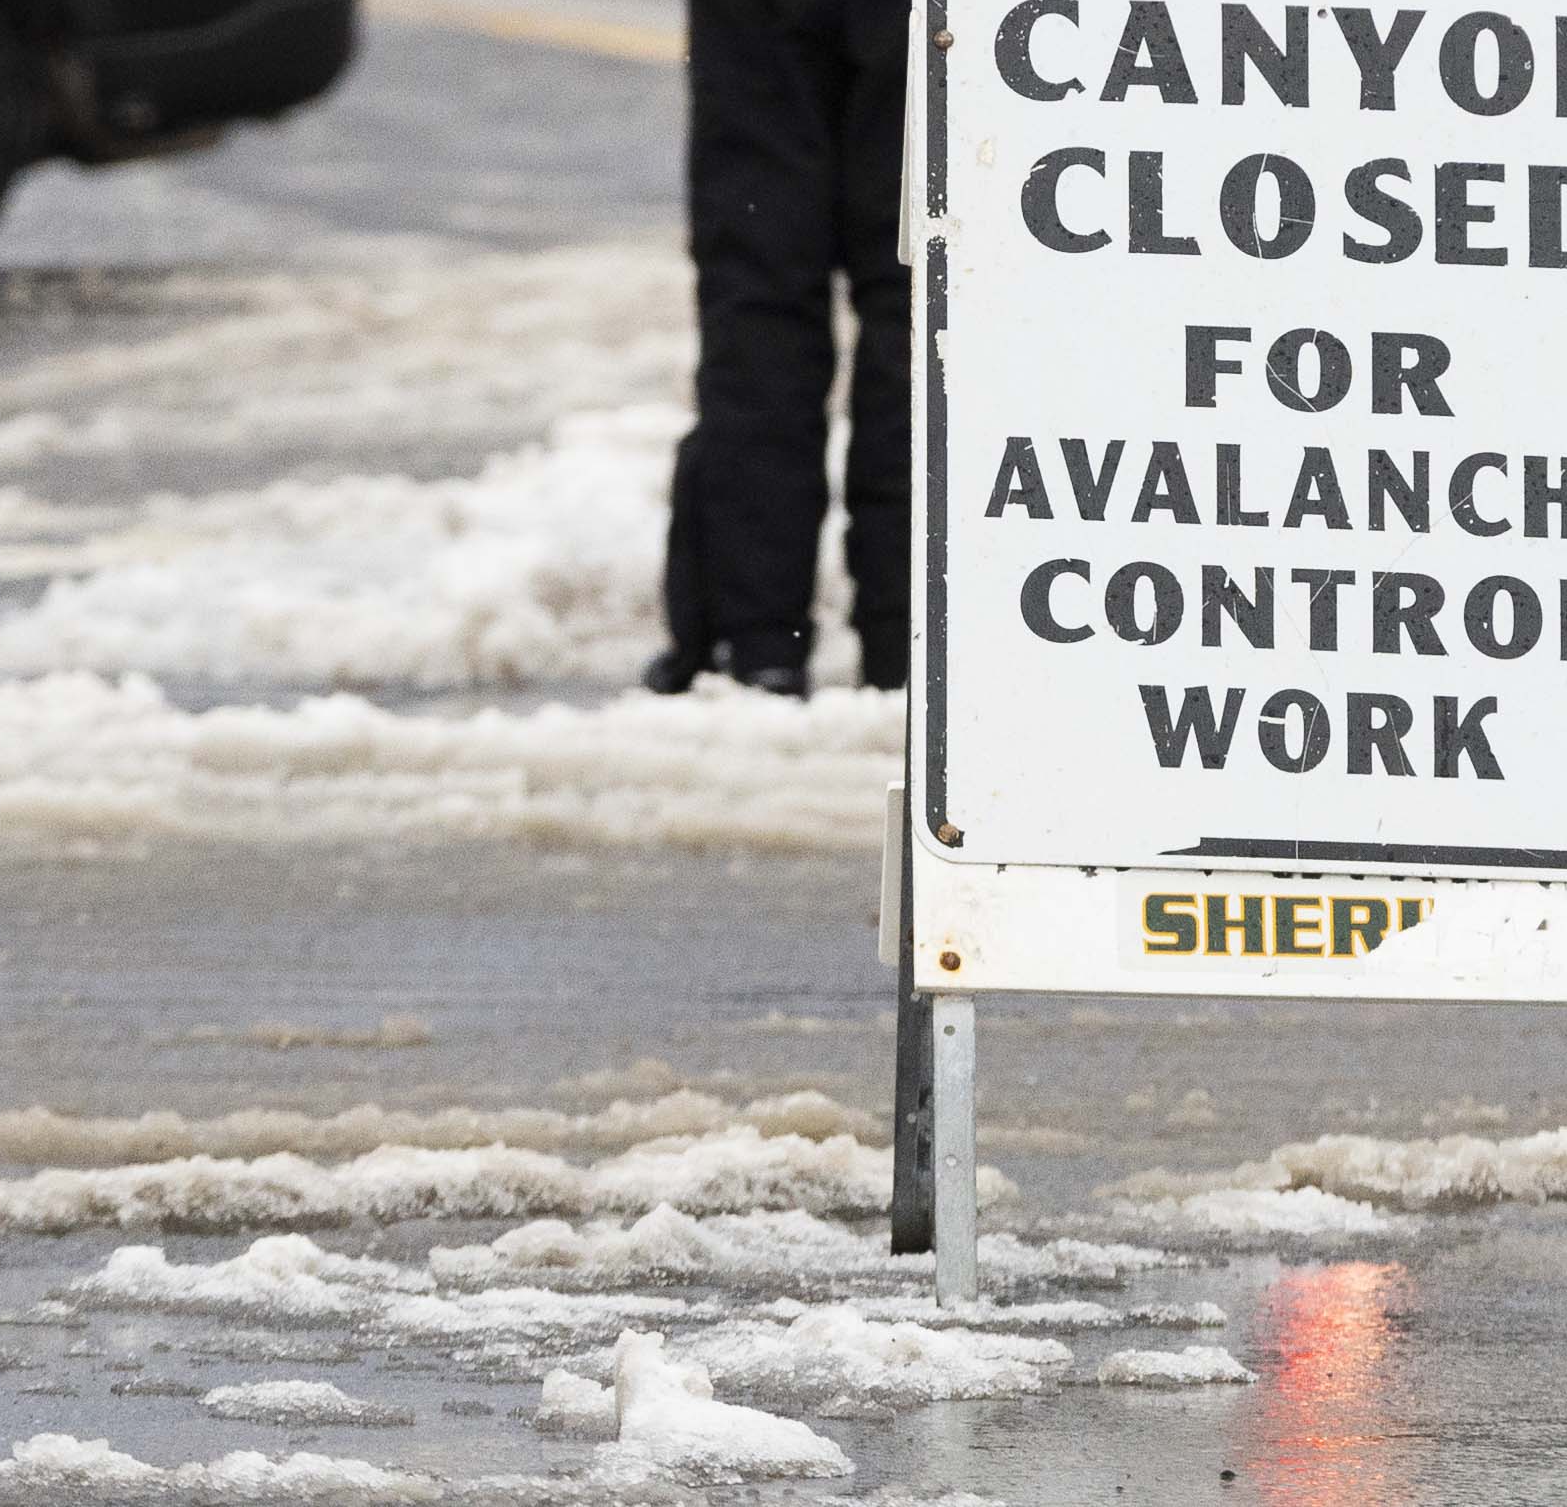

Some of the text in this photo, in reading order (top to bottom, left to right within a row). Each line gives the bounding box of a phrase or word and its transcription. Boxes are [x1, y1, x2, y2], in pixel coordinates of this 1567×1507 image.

[1185, 324, 1456, 417] FOR
[1137, 684, 1506, 781] WORK
[1142, 892, 1435, 958] SHERI
